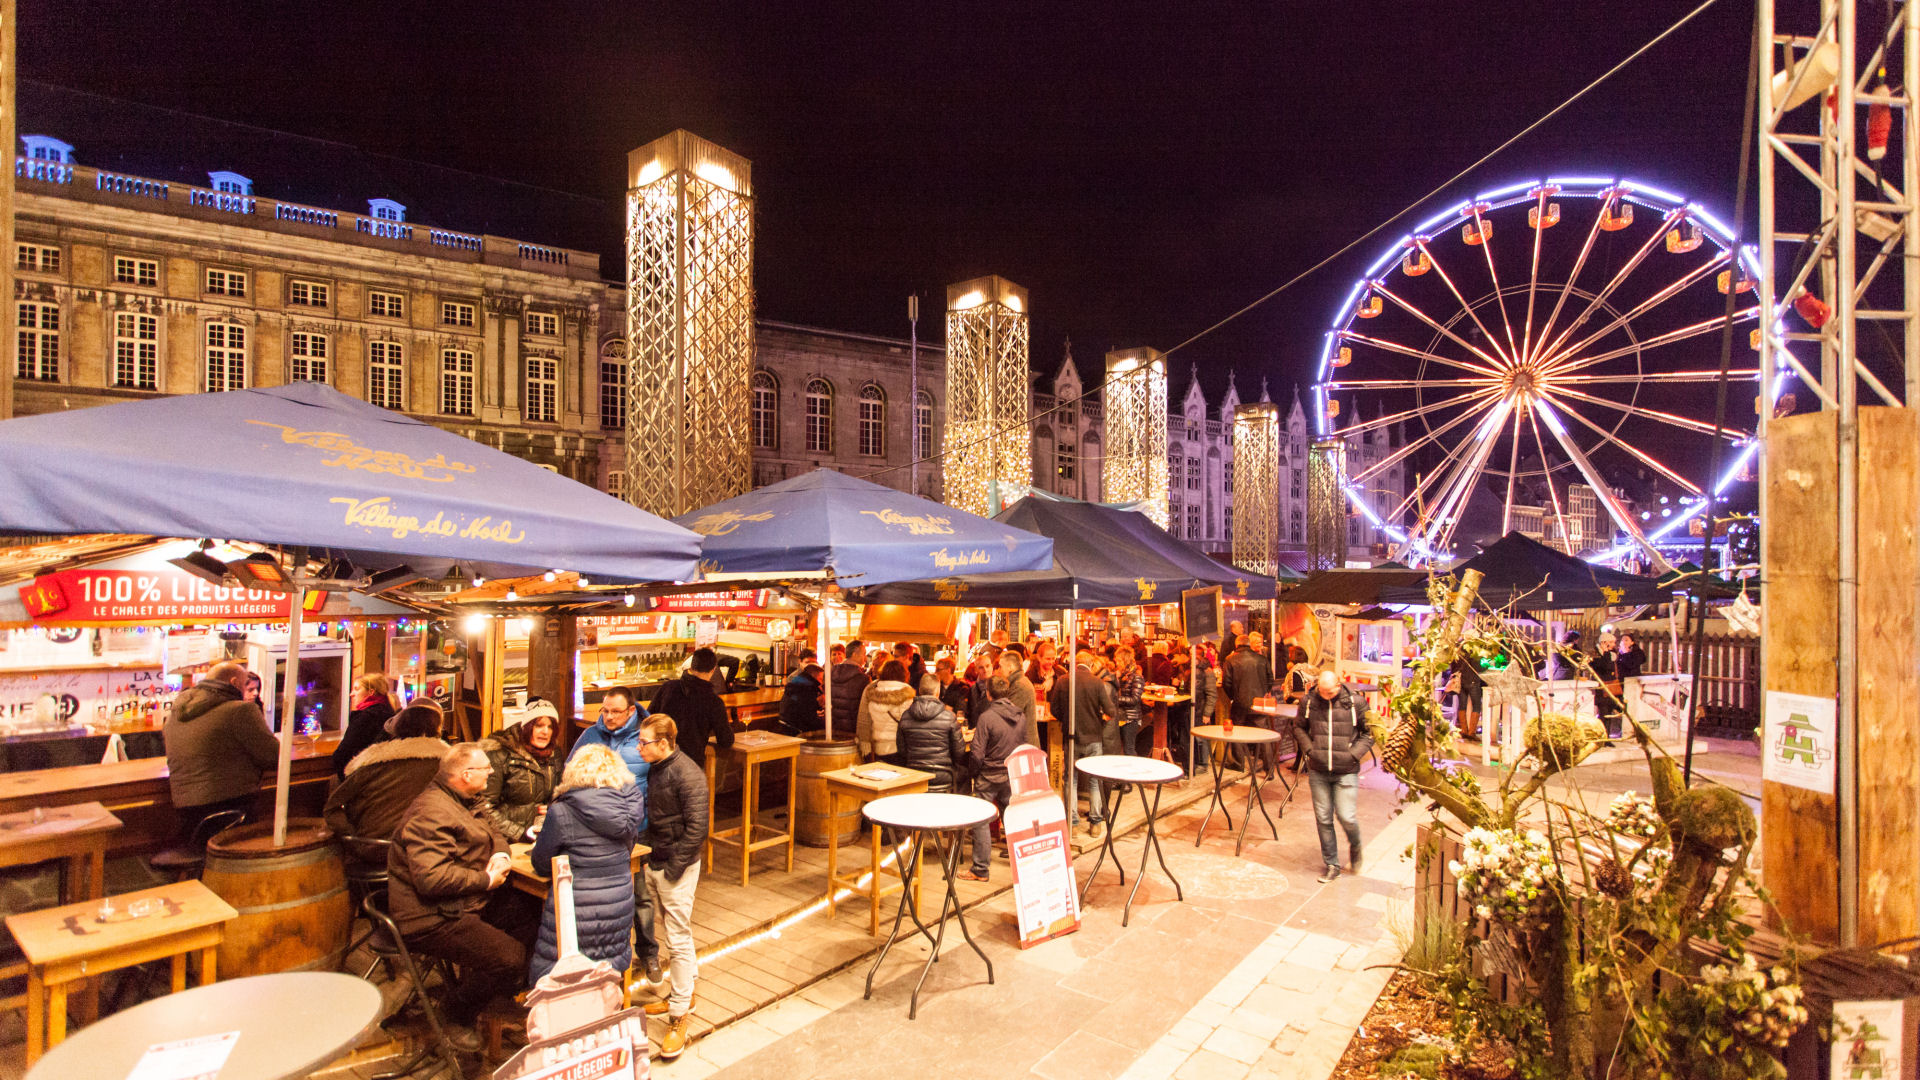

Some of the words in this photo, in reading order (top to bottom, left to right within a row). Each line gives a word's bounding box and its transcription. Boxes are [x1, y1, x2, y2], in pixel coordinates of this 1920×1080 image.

[330, 497, 419, 539] Village
[419, 511, 458, 537] de
[93, 606, 107, 616] LE
[112, 605, 154, 616] CHALET
[158, 605, 178, 615] DES
[182, 604, 231, 615] PRODUITS
[234, 603, 277, 614] LIÉGEOIS
[134, 671, 152, 682] LA
[567, 1053, 613, 1080] LIÉGEOIS
